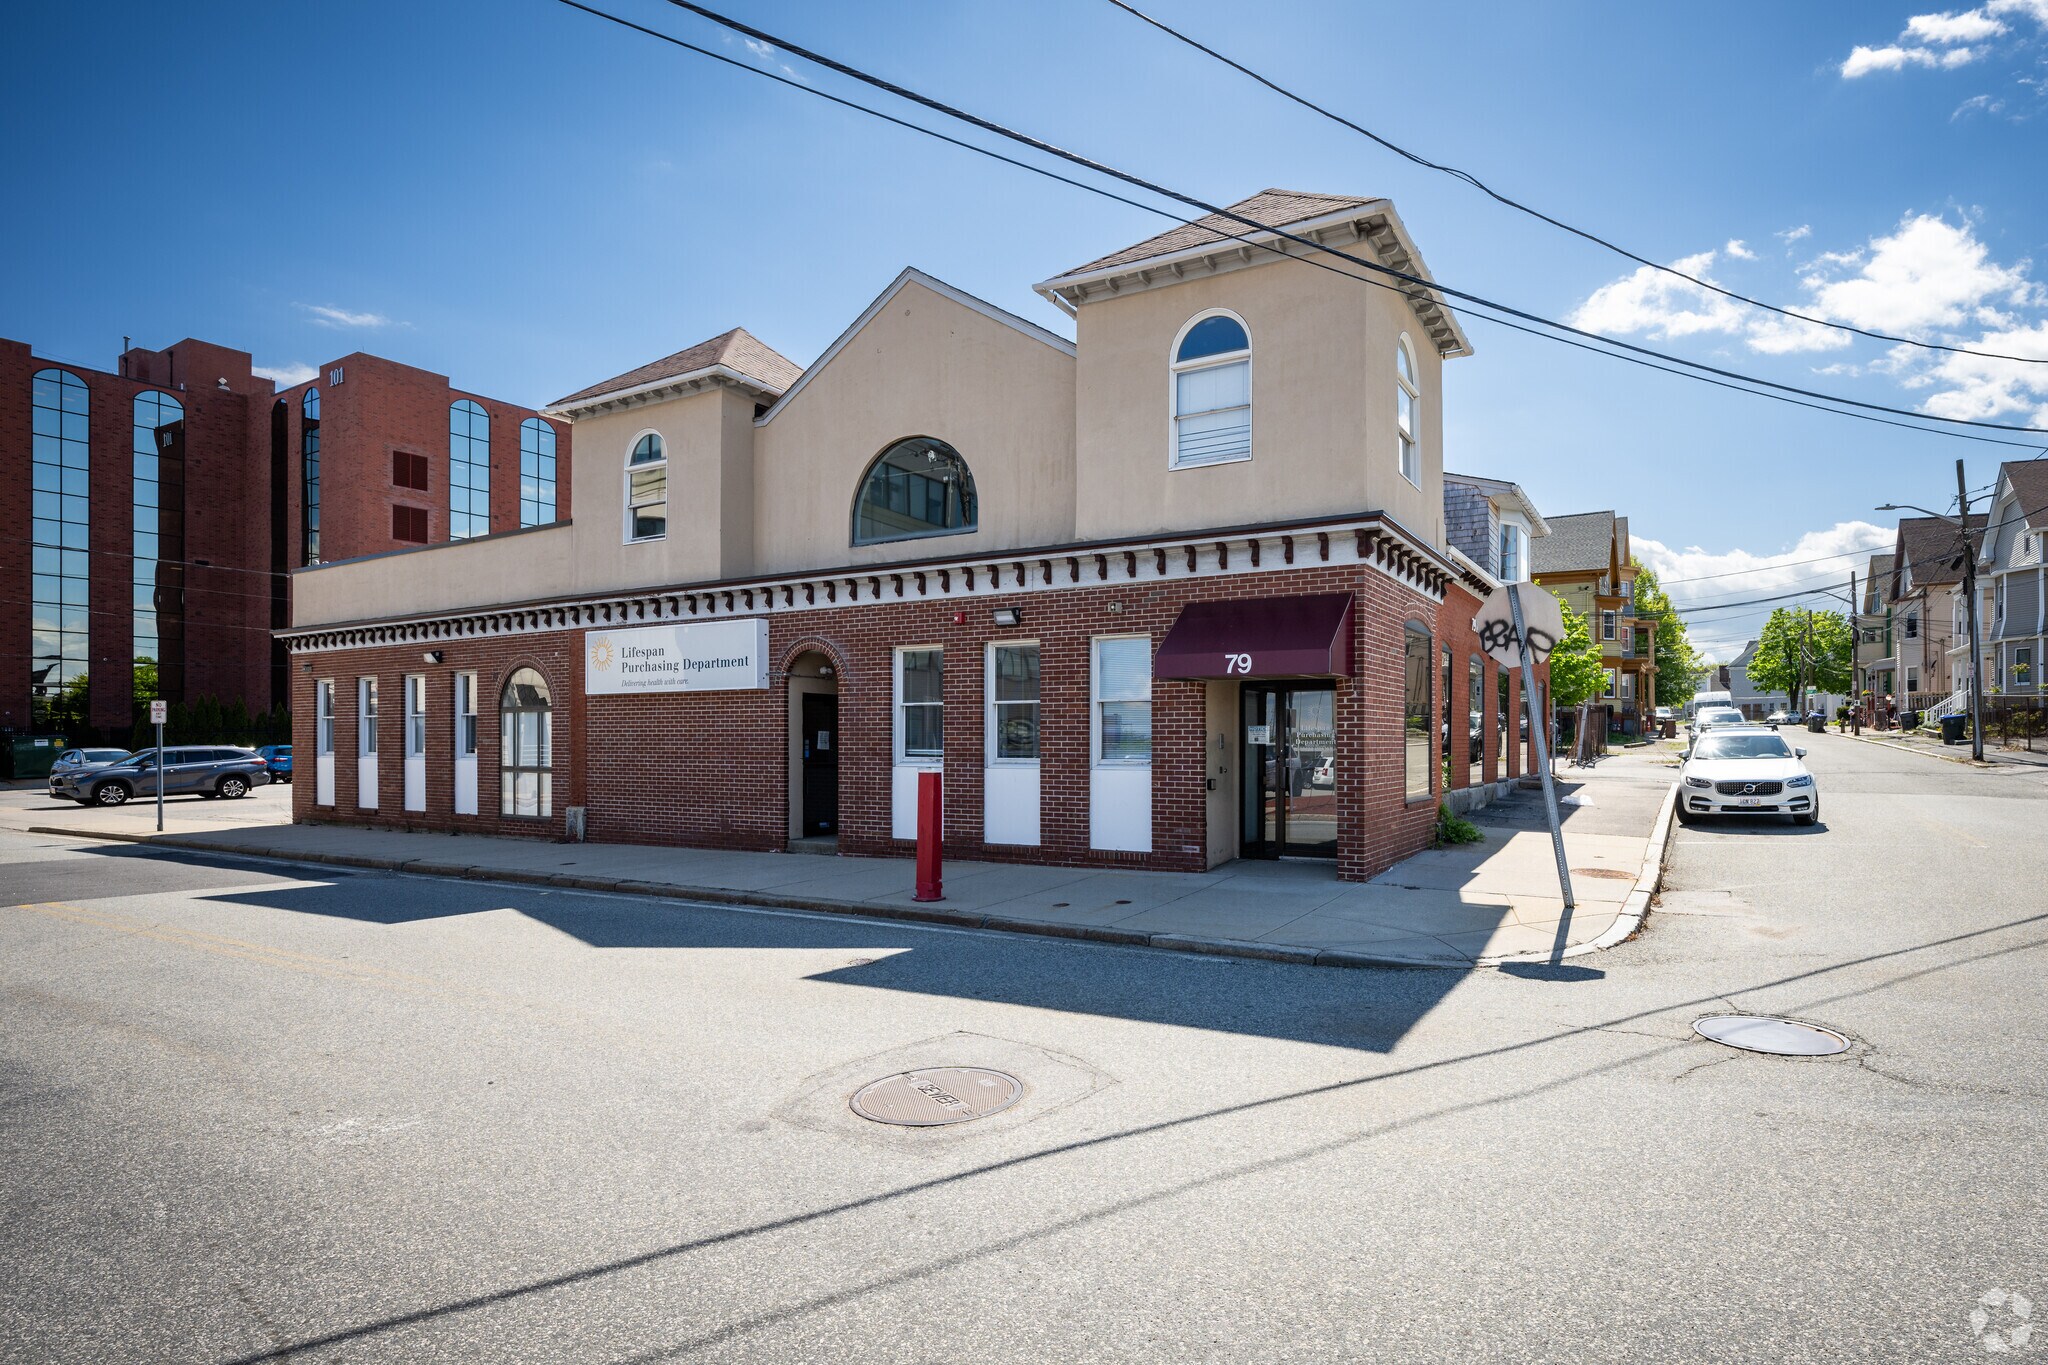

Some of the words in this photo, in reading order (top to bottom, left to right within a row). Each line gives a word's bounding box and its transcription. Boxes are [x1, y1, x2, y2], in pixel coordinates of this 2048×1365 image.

[329, 366, 345, 387] 101
[621, 647, 665, 659] Lifespan
[621, 660, 680, 673] Purchasing
[683, 656, 749, 672] Department
[1225, 653, 1253, 674] 79
[621, 680, 647, 688] Delivering
[664, 678, 676, 686] with
